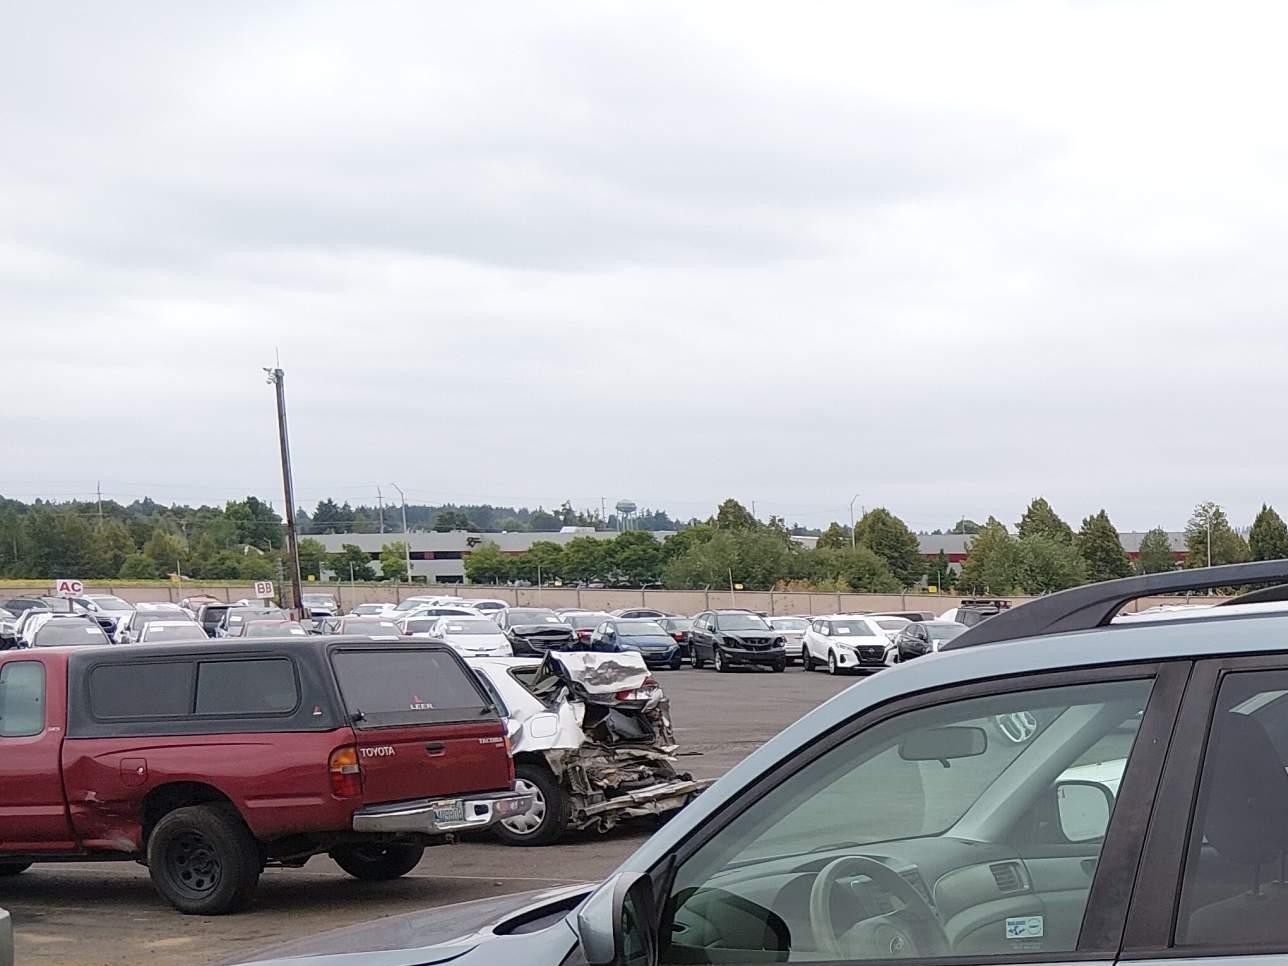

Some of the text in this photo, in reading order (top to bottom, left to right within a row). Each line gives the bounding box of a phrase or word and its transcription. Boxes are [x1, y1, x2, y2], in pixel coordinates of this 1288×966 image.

[59, 581, 82, 593] AC
[256, 583, 272, 594] BB
[359, 746, 396, 758] TOYOTA
